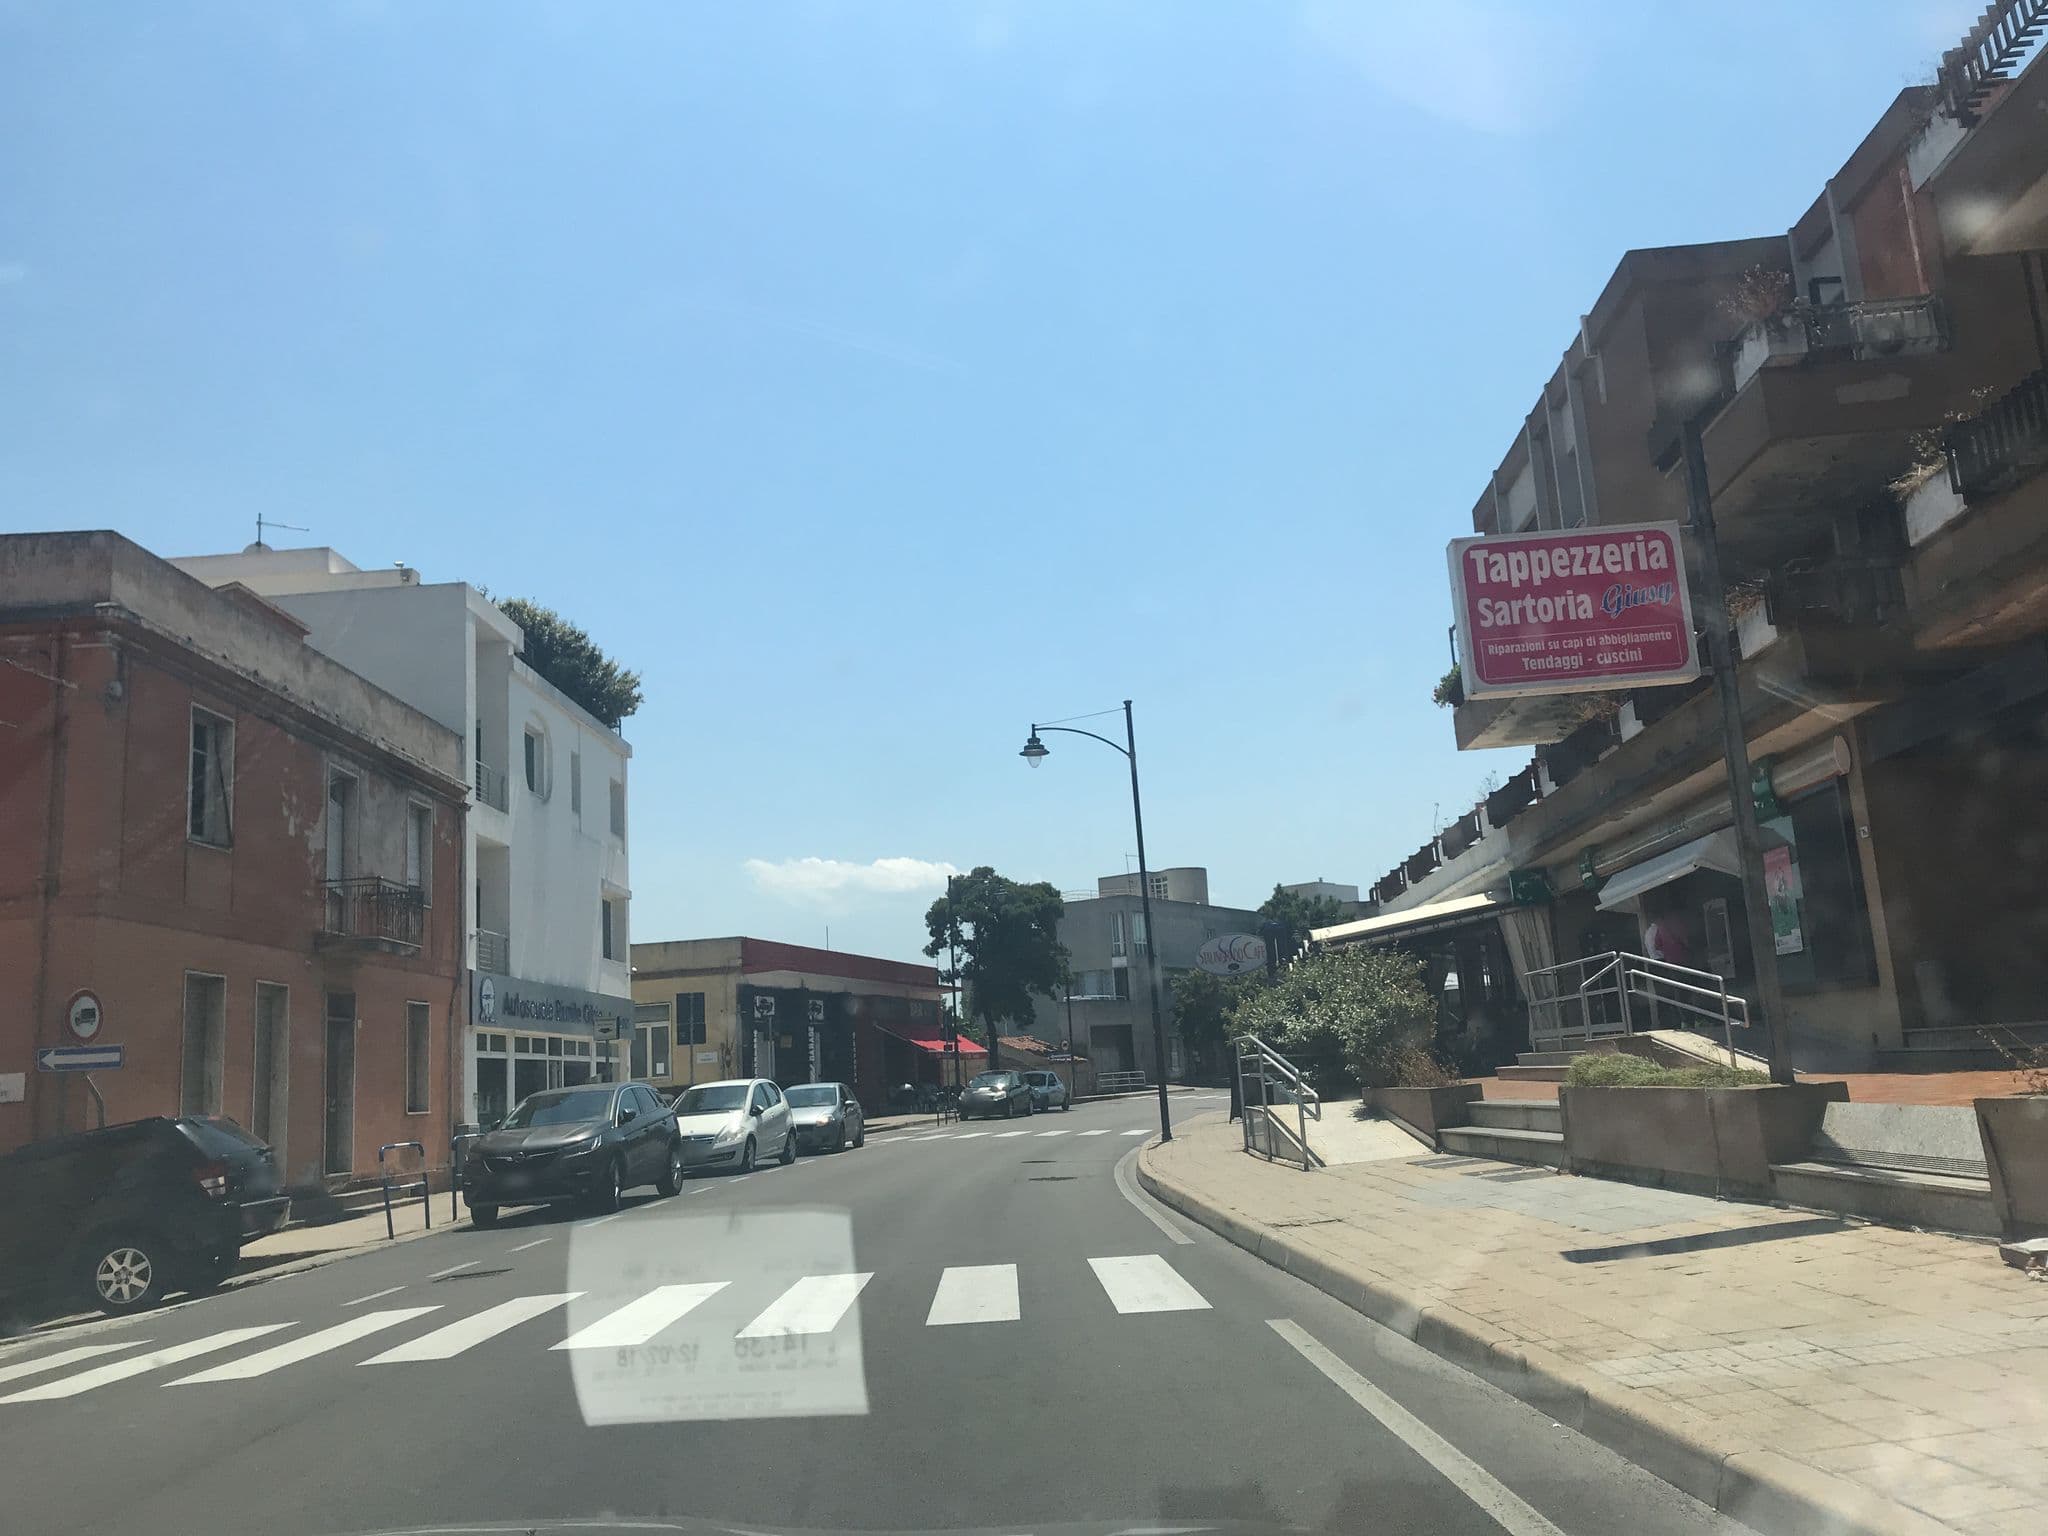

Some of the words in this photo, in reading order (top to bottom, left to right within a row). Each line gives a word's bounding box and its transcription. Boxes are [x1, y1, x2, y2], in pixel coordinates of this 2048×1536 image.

[1470, 535, 1669, 588] Tappezzeria
[1479, 590, 1593, 628] Sartoria
[1600, 582, 1676, 619] Giusy
[1488, 641, 1545, 655] Riparazioni
[1548, 640, 1559, 650] su
[1563, 637, 1583, 649] capi
[1586, 635, 1596, 647] di
[1599, 631, 1672, 646] abbigliamento
[1522, 652, 1583, 670] Tendaggi
[1596, 648, 1643, 665] cuscini
